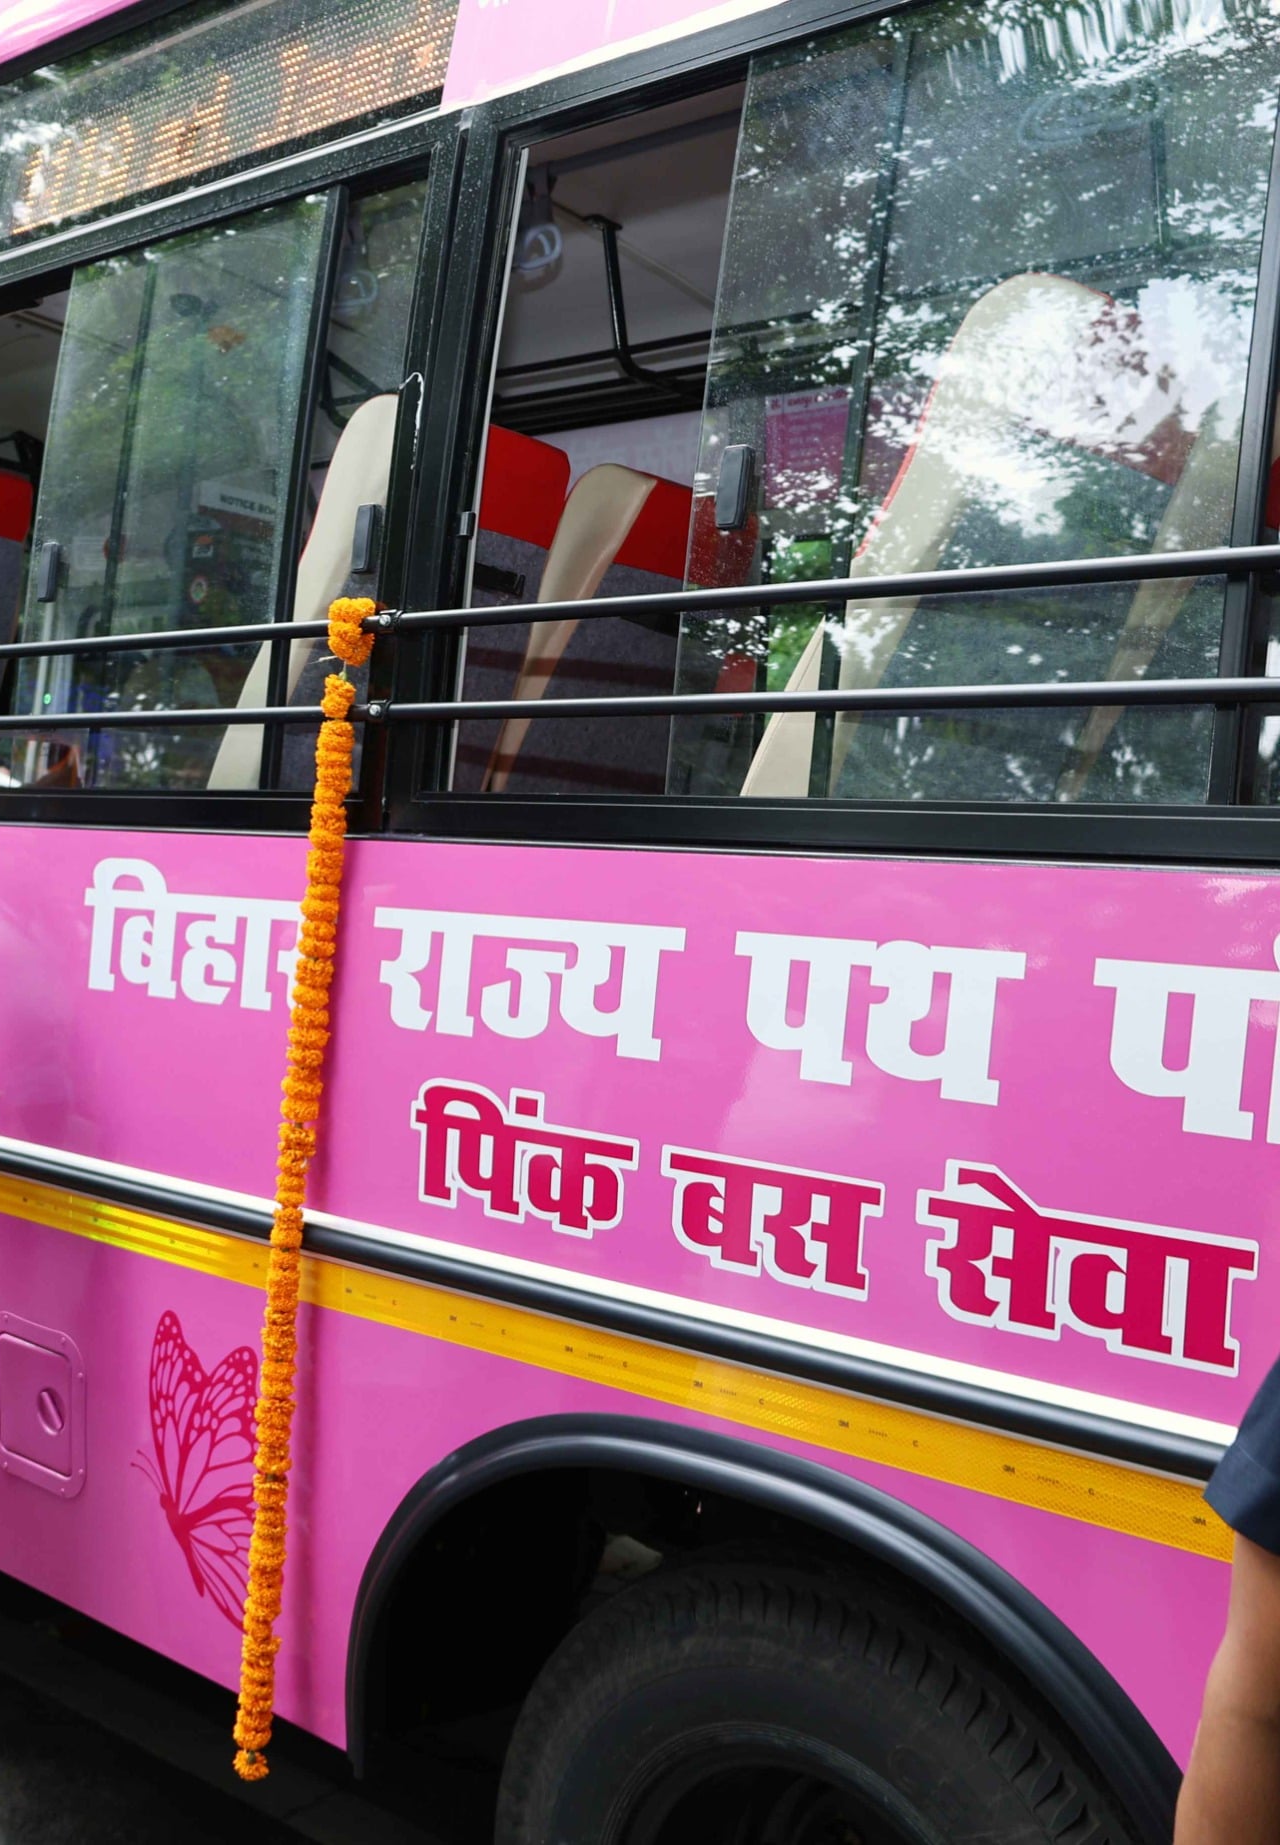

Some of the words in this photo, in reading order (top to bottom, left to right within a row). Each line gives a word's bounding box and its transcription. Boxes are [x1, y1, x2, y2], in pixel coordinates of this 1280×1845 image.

[373, 906, 686, 1061] राज्य
[734, 930, 1027, 1107] पथ
[410, 1076, 639, 1239] पिंक
[661, 1143, 885, 1302] बस
[916, 1157, 1260, 1377] सेवा
